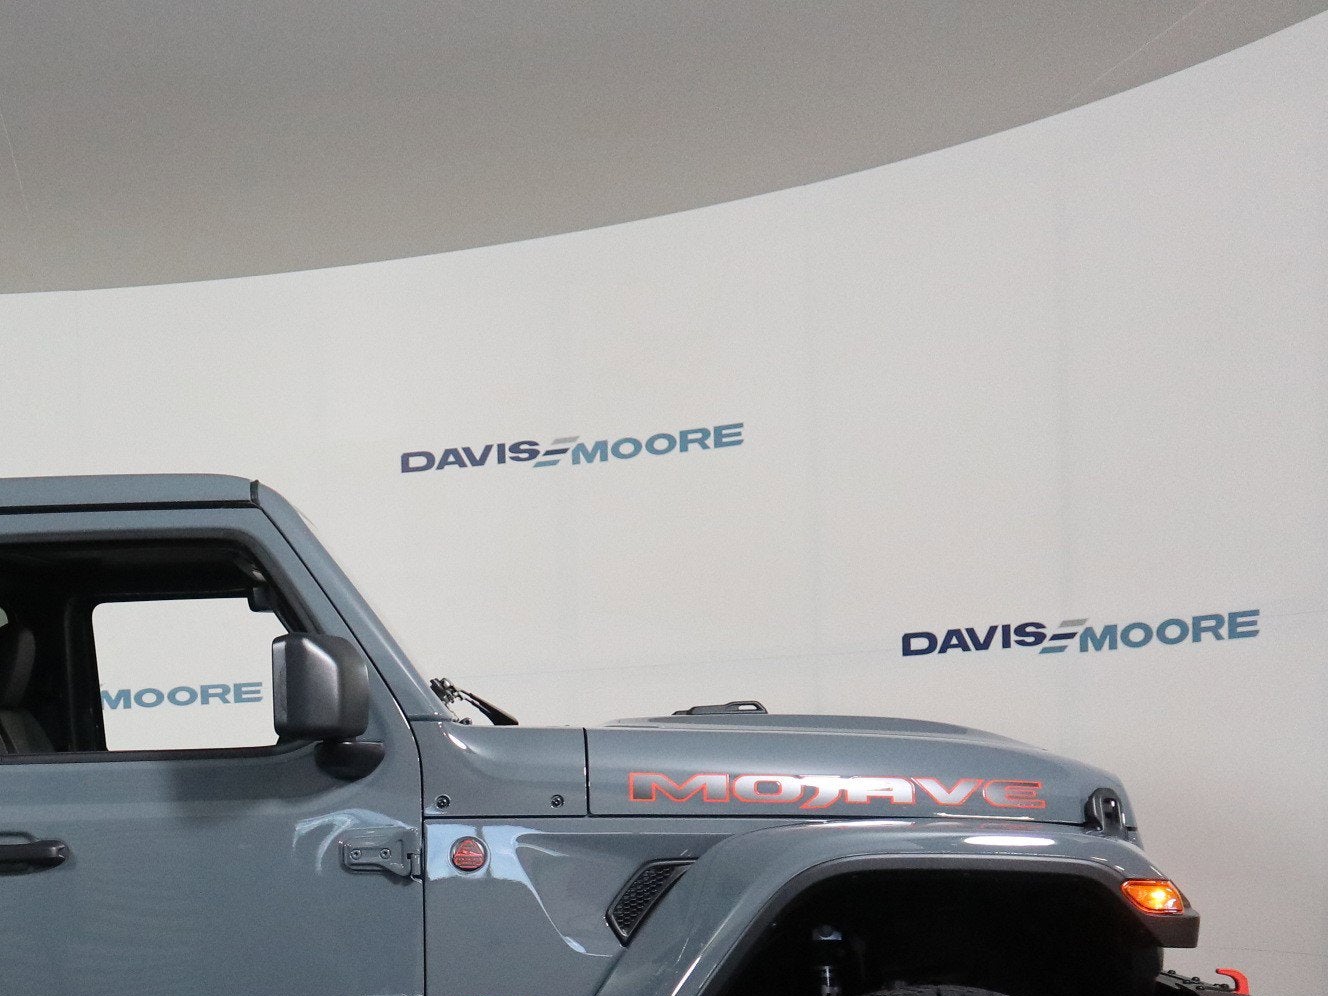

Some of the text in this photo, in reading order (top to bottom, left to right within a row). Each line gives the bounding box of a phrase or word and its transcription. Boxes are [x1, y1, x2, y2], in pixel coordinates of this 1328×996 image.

[401, 422, 744, 473] DAVIS MOORE
[902, 609, 1260, 657] DAVIS MOORE
[101, 682, 263, 710] MOORE
[628, 771, 1046, 809] MOJAVE
